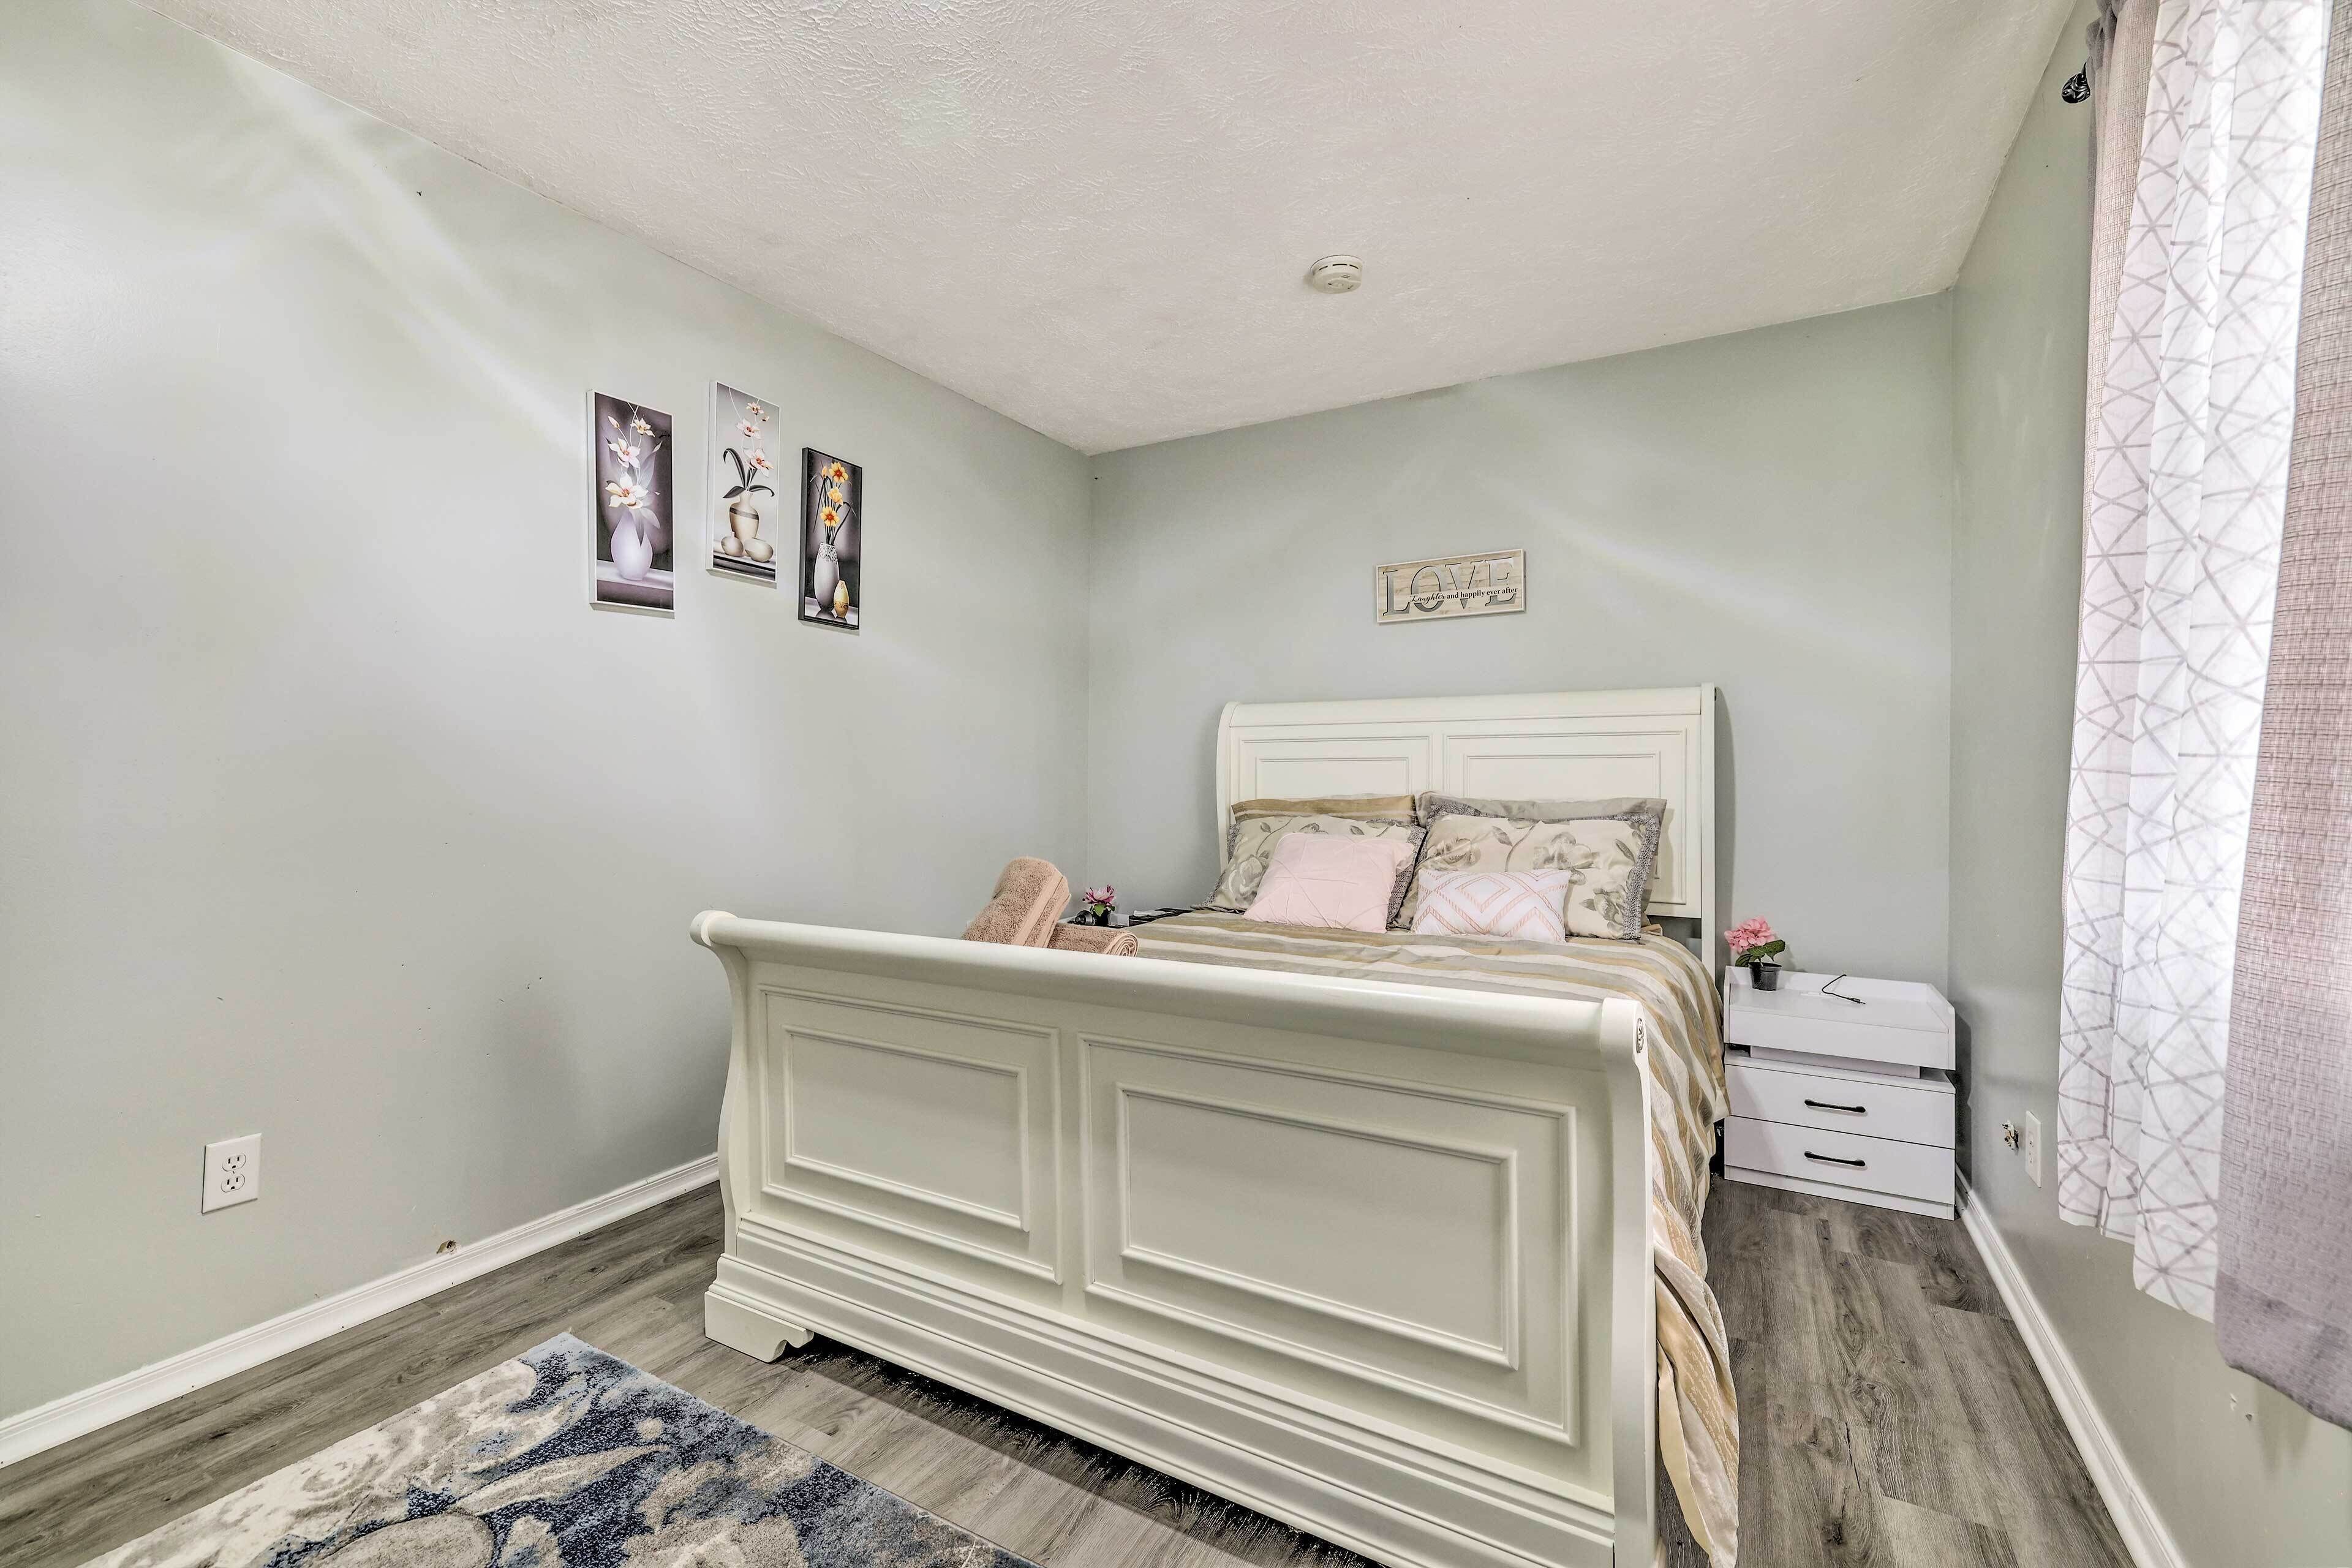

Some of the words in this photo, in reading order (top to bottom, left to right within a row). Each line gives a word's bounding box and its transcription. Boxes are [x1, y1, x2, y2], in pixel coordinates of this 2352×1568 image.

[1382, 557, 1517, 616] LOVE
[1411, 592, 1446, 605] Laughter
[1460, 590, 1485, 599] happily
